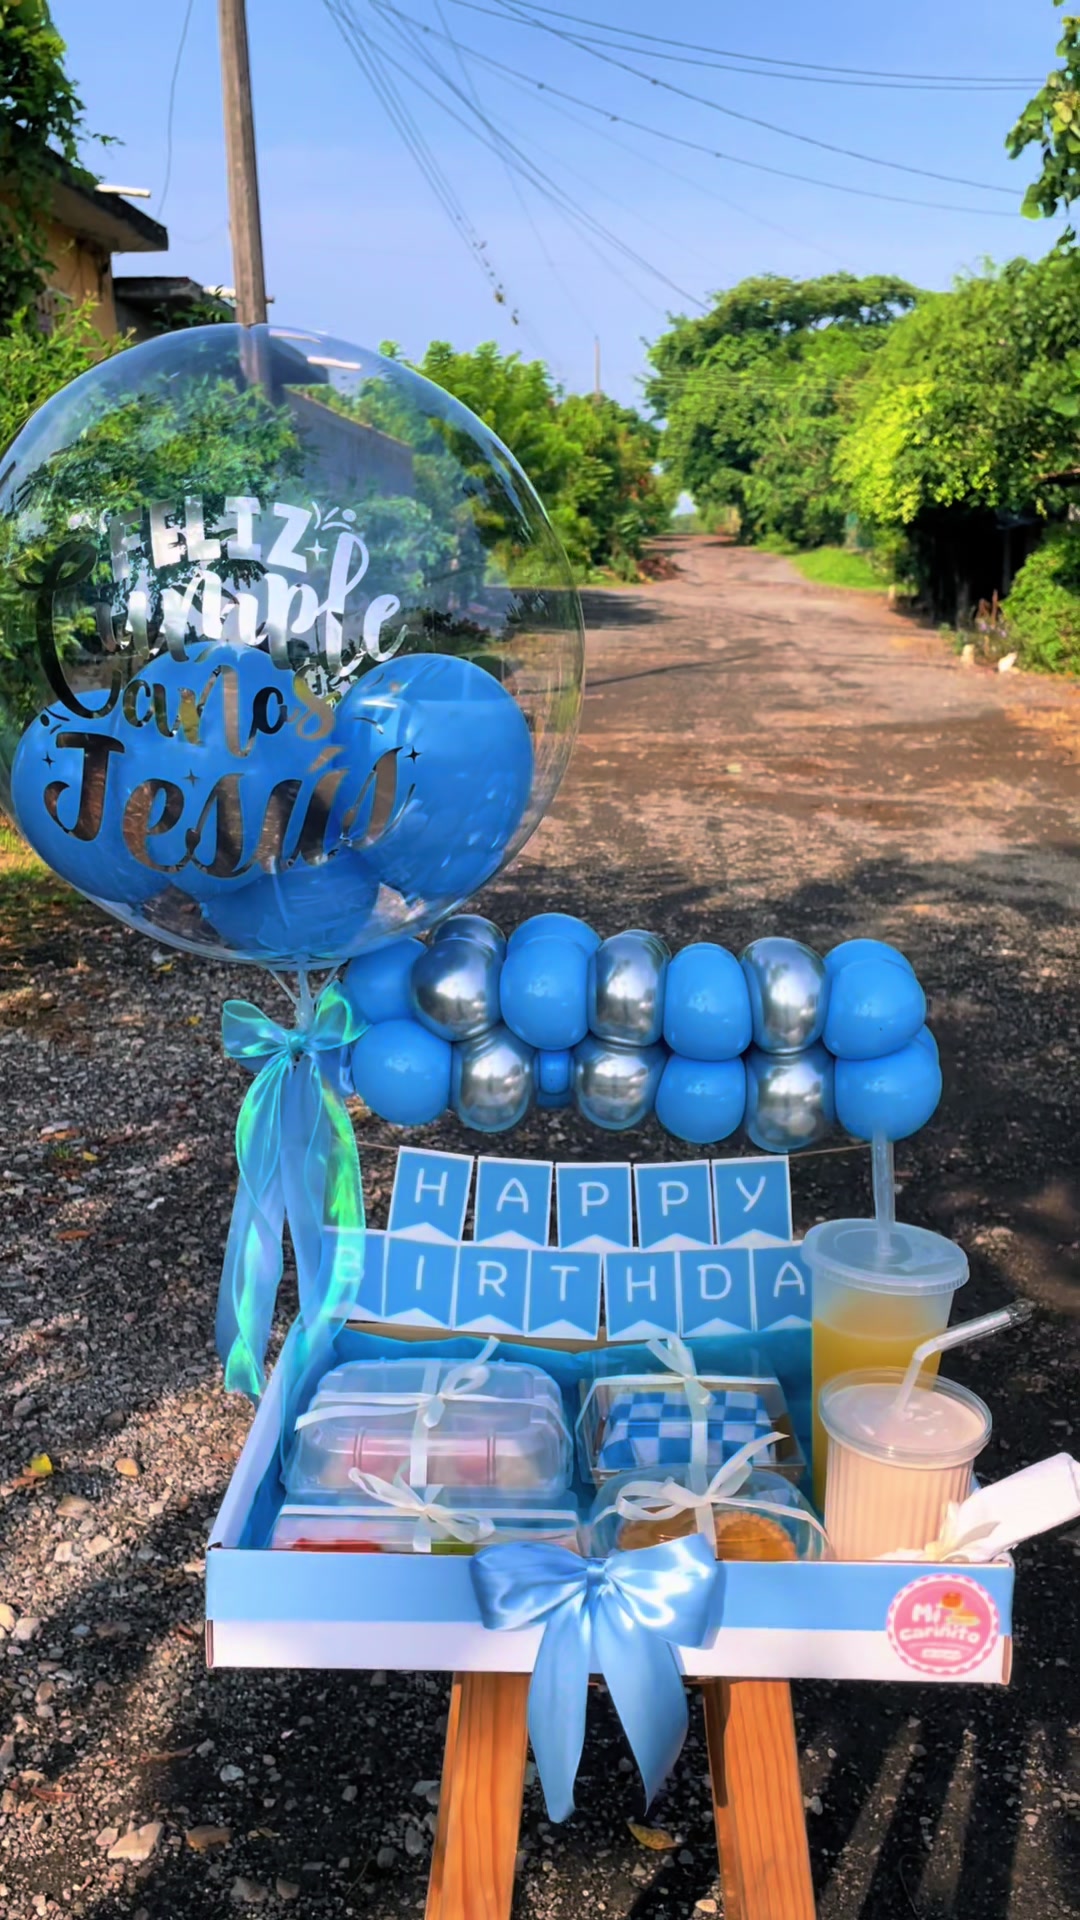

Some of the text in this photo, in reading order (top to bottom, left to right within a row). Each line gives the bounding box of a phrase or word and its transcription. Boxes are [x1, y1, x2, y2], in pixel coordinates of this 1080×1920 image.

[110, 496, 313, 583] FELIZ
[415, 1167, 766, 1217] HAPPY
[336, 1248, 806, 1303] BIRTHDA
